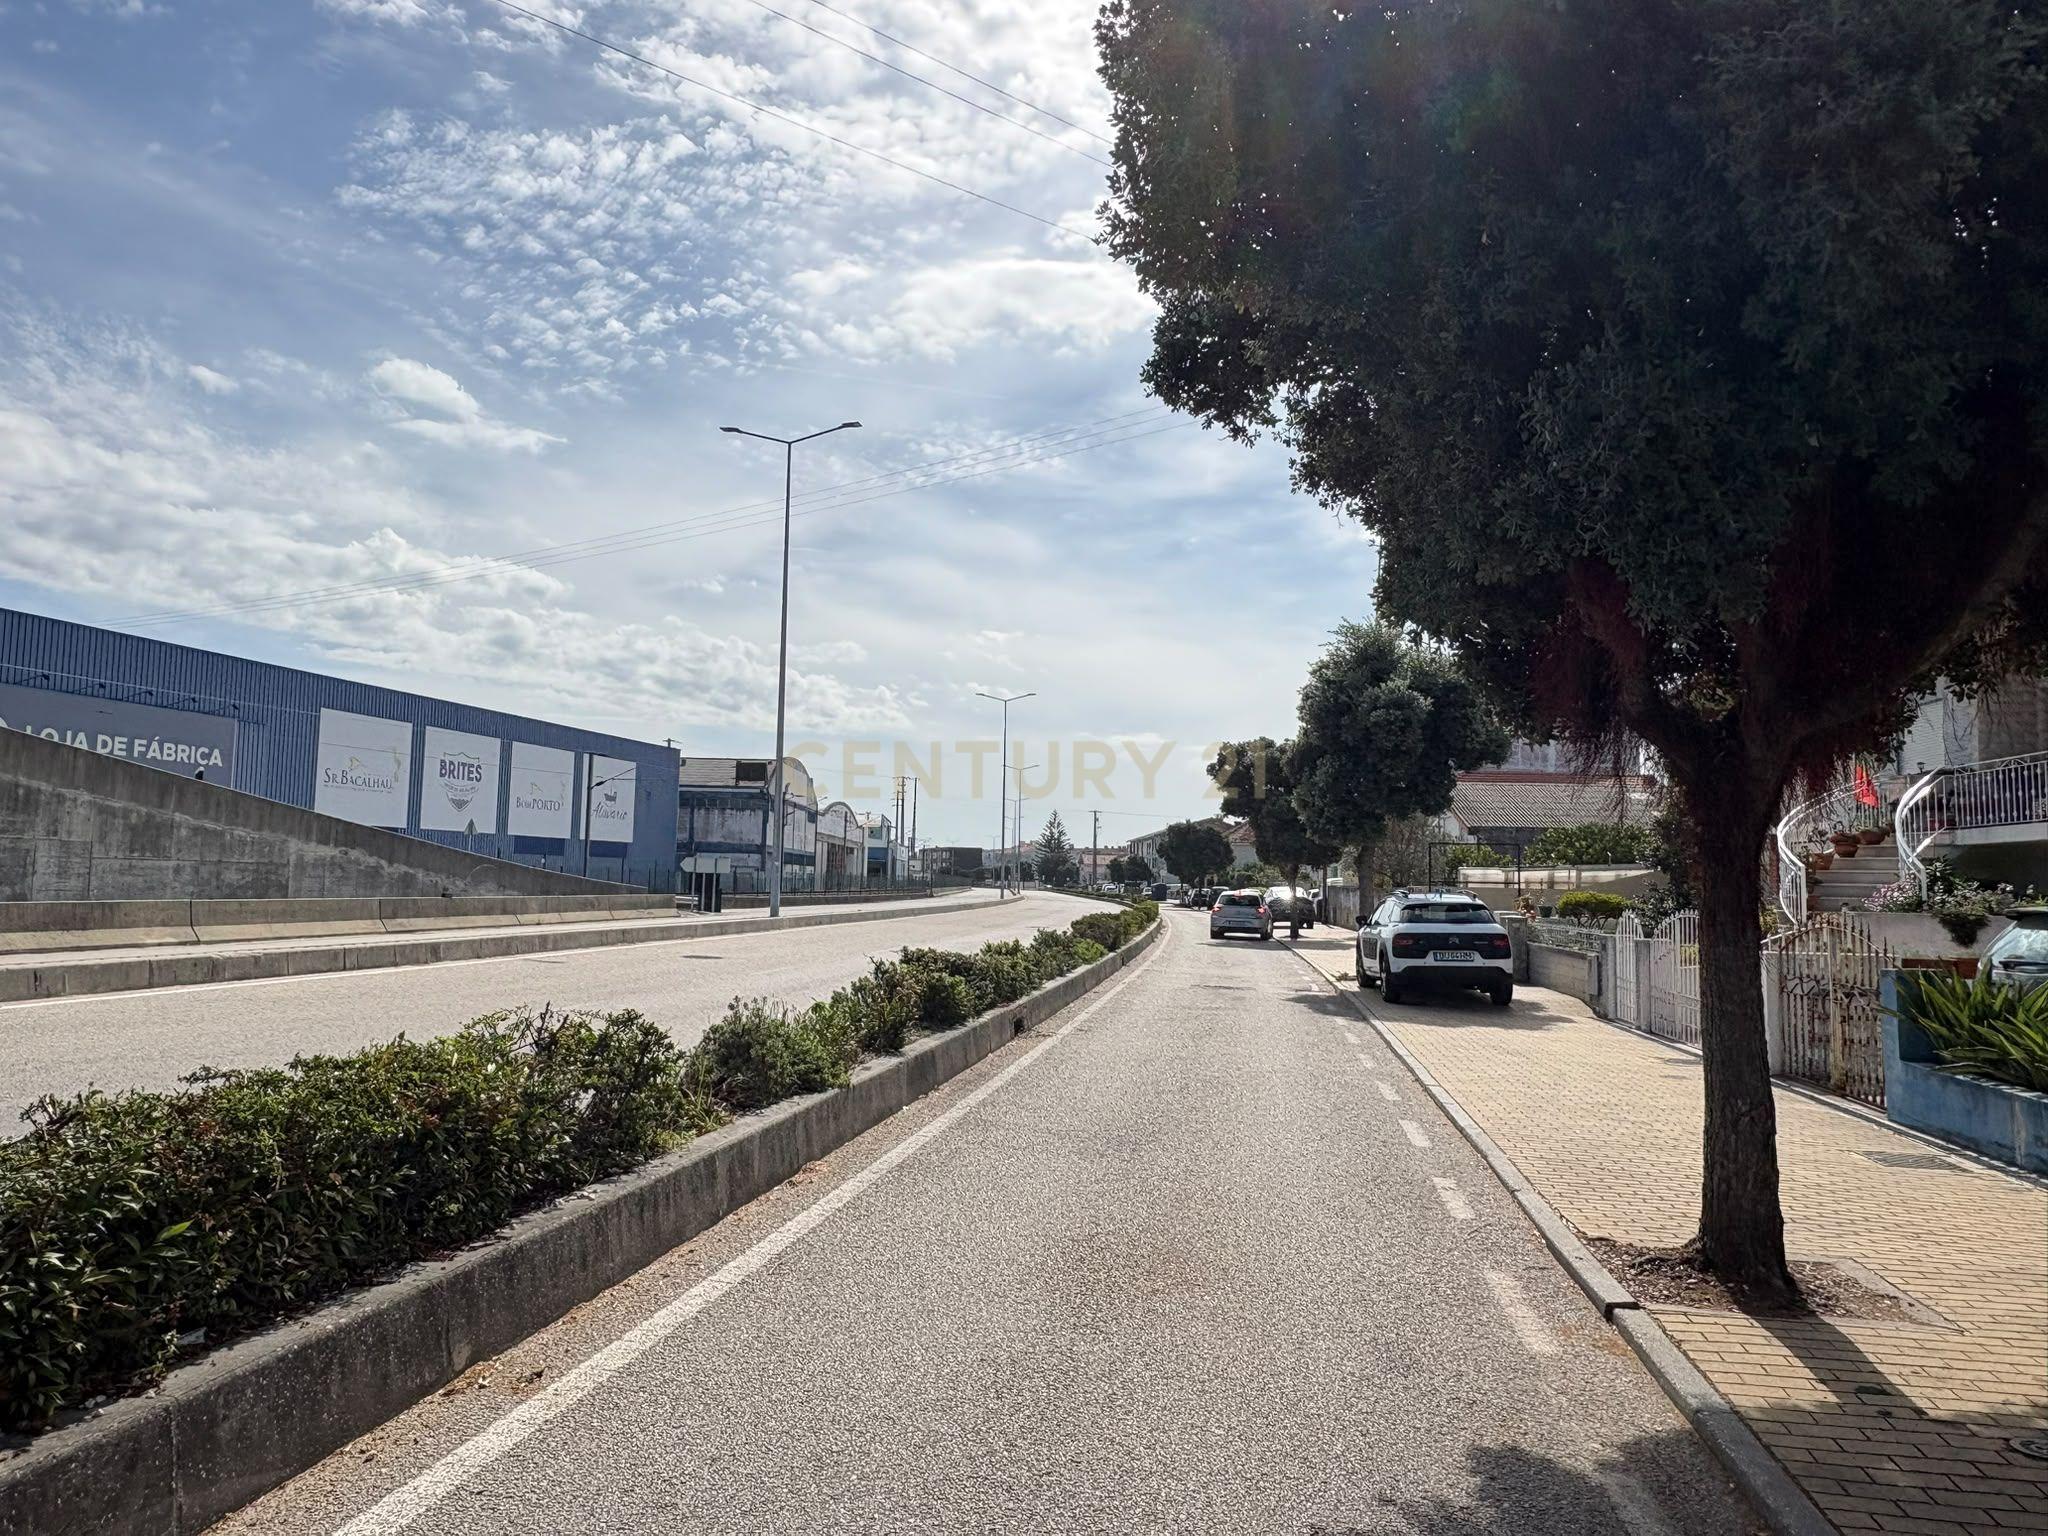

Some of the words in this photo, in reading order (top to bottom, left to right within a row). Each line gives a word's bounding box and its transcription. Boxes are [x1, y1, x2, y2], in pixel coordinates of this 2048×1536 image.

[96, 732, 128, 756] DE
[133, 736, 223, 767] FÁBRICA
[439, 759, 482, 783] BRITES
